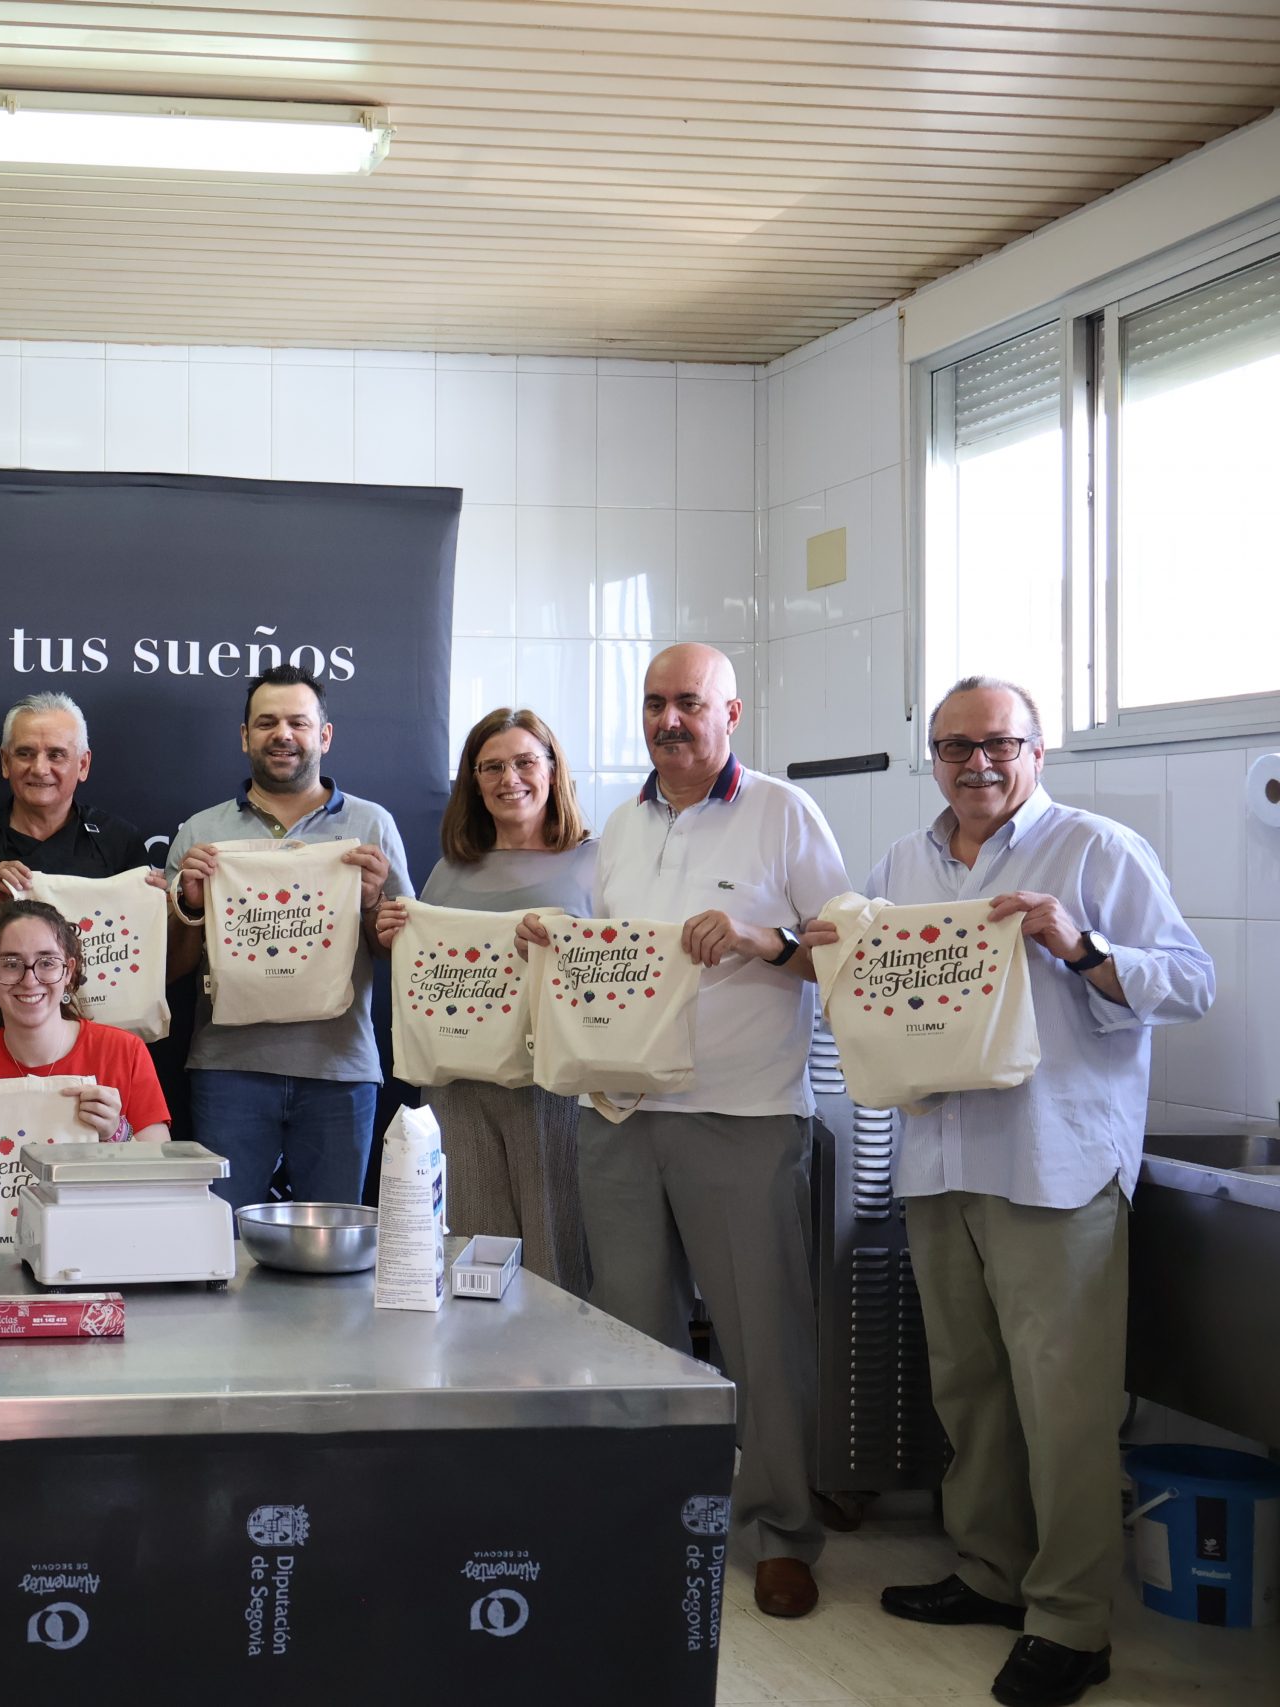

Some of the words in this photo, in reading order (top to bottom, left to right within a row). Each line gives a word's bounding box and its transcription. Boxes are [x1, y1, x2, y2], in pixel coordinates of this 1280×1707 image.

[9, 629, 109, 673] tus
[133, 625, 356, 682] sueños
[225, 906, 311, 931] Alimenta
[81, 932, 115, 952] enta
[237, 928, 249, 937] tu
[247, 918, 322, 946] Felicidad
[83, 944, 128, 967] icidad
[558, 946, 638, 971] Alimenta
[854, 944, 968, 979] Alimenta
[411, 964, 498, 983] Alimenta
[571, 962, 650, 990] Felicidad
[870, 974, 883, 985] tu
[882, 960, 984, 997] Felicidad
[420, 981, 432, 991] tu
[428, 980, 507, 1002] Felicidad
[906, 1022, 945, 1032] muMU
[251, 1555, 269, 1580] de
[686, 1545, 704, 1570] de
[272, 1556, 294, 1655] Diputación
[708, 1545, 725, 1648] Diputación
[245, 1586, 268, 1656] Segovia
[682, 1576, 705, 1651] Segovia
